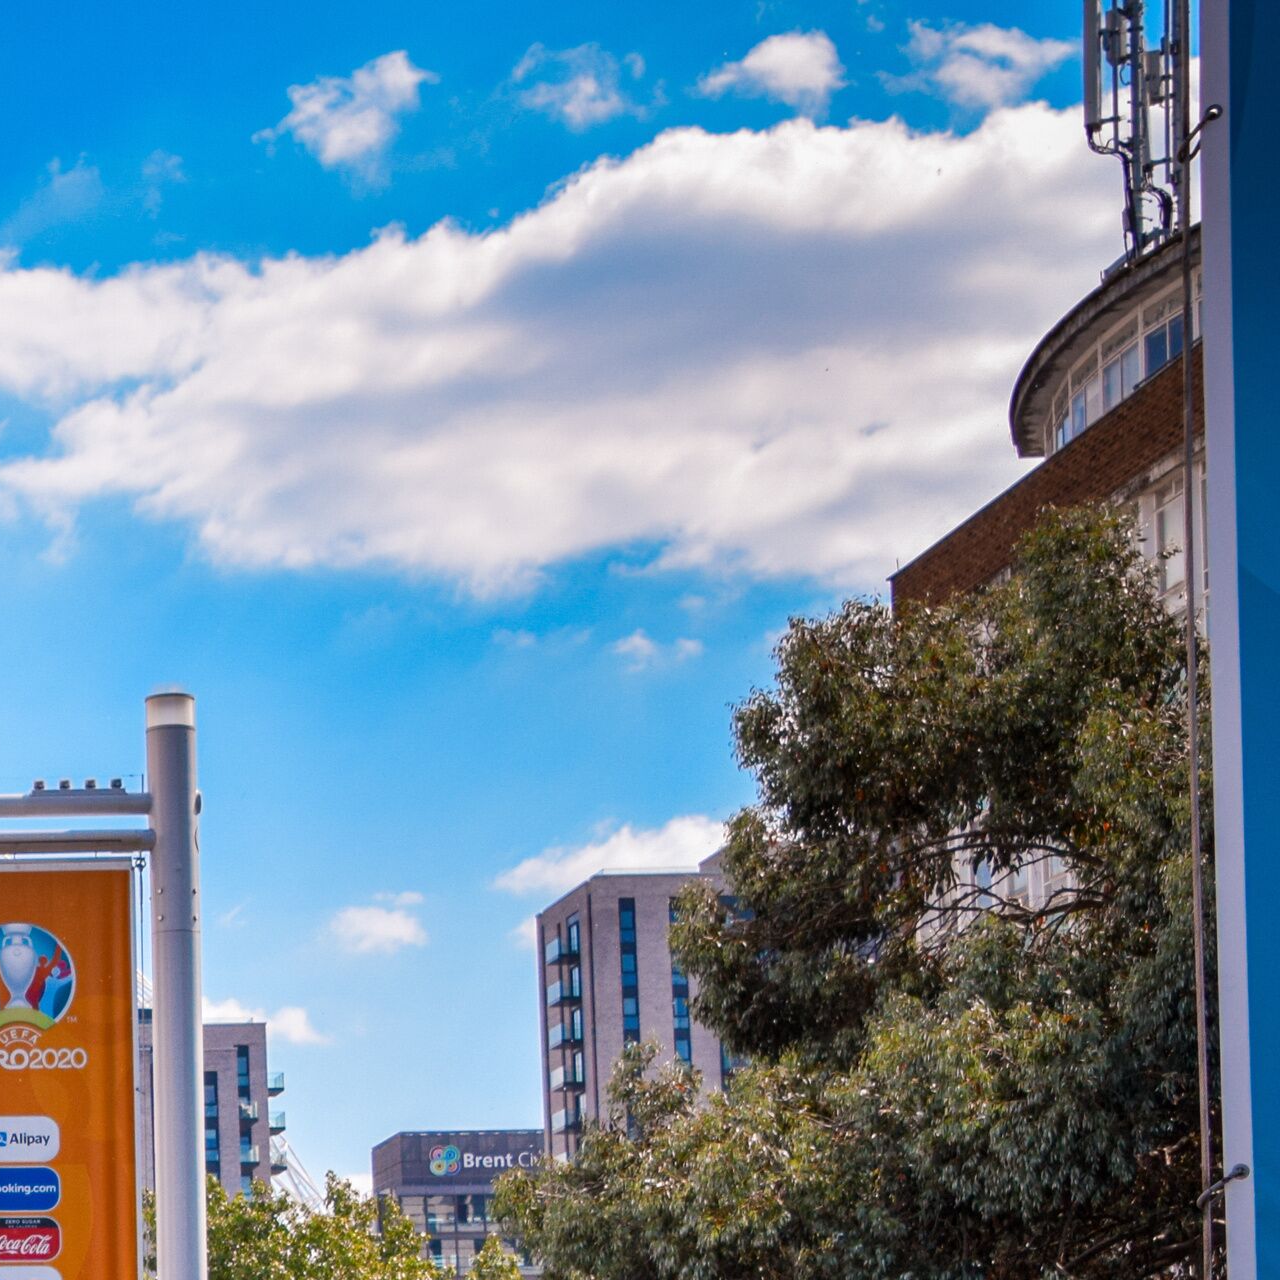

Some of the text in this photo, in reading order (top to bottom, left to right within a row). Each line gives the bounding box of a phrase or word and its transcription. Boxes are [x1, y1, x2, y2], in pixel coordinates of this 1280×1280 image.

[0, 1028, 39, 1046] UEFA
[10, 1132, 50, 1146] Alipay
[463, 1151, 541, 1168] Brent Civ
